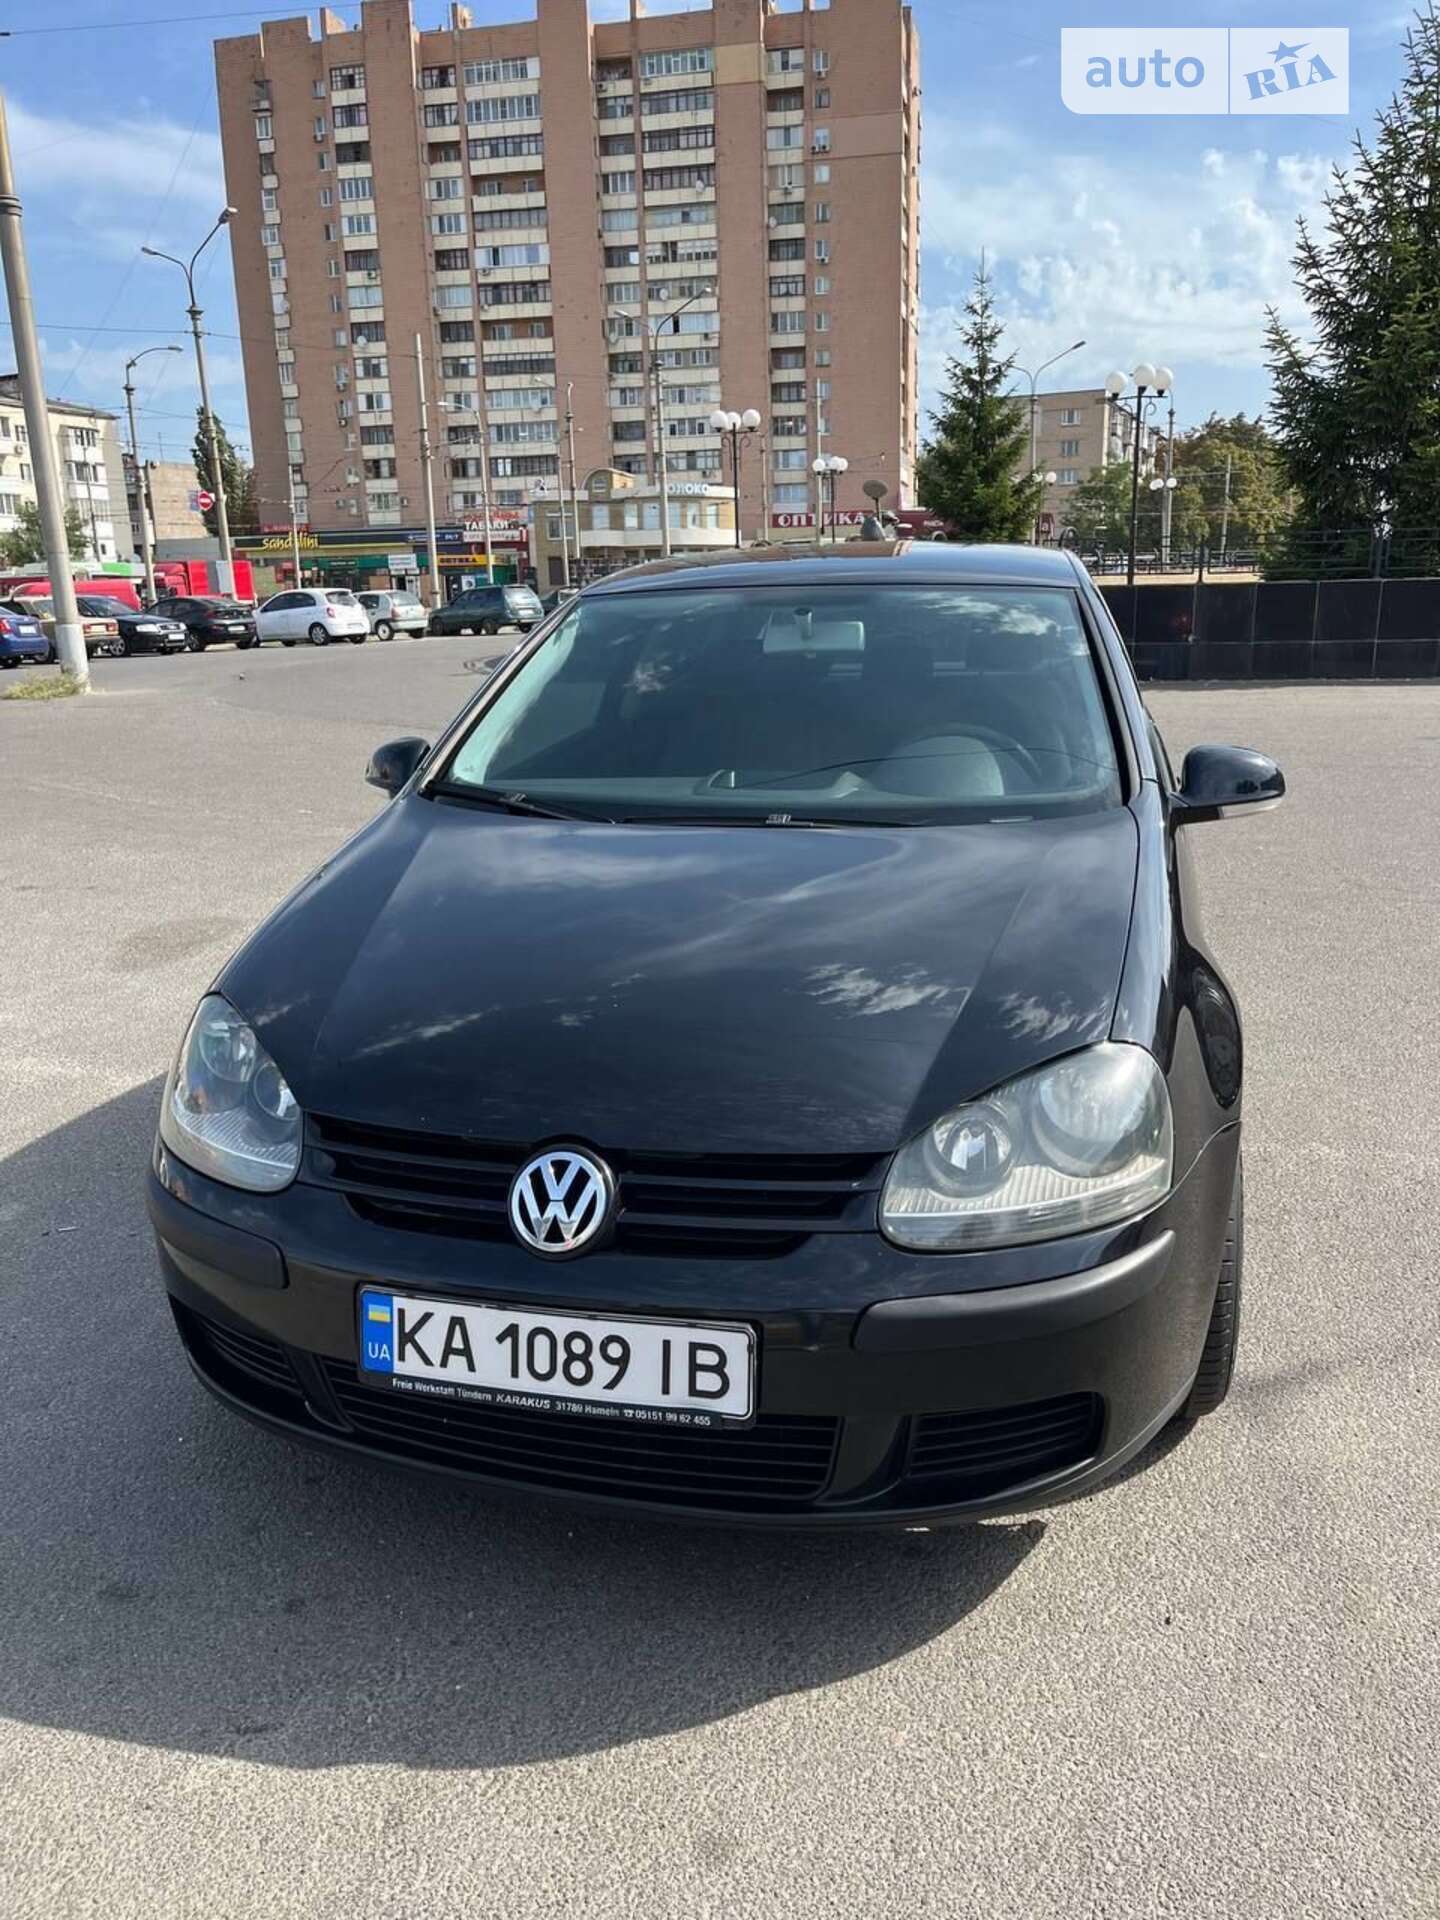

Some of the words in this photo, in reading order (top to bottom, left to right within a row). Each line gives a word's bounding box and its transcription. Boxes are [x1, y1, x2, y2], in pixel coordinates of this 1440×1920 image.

[777, 511, 865, 528] ОПТИКА
[368, 1343, 391, 1362] UA
[397, 1307, 477, 1373] KA
[495, 1322, 632, 1391] 1089
[661, 1338, 731, 1400] IB
[392, 1377, 413, 1390] Freie
[414, 1381, 456, 1396] Werkstatt
[457, 1387, 492, 1401] Tündern
[496, 1393, 551, 1410] KARAKUS
[554, 1400, 583, 1413] 31789
[584, 1405, 620, 1417] Hameln
[635, 1410, 663, 1421] 05151
[692, 1414, 711, 1427] 455
